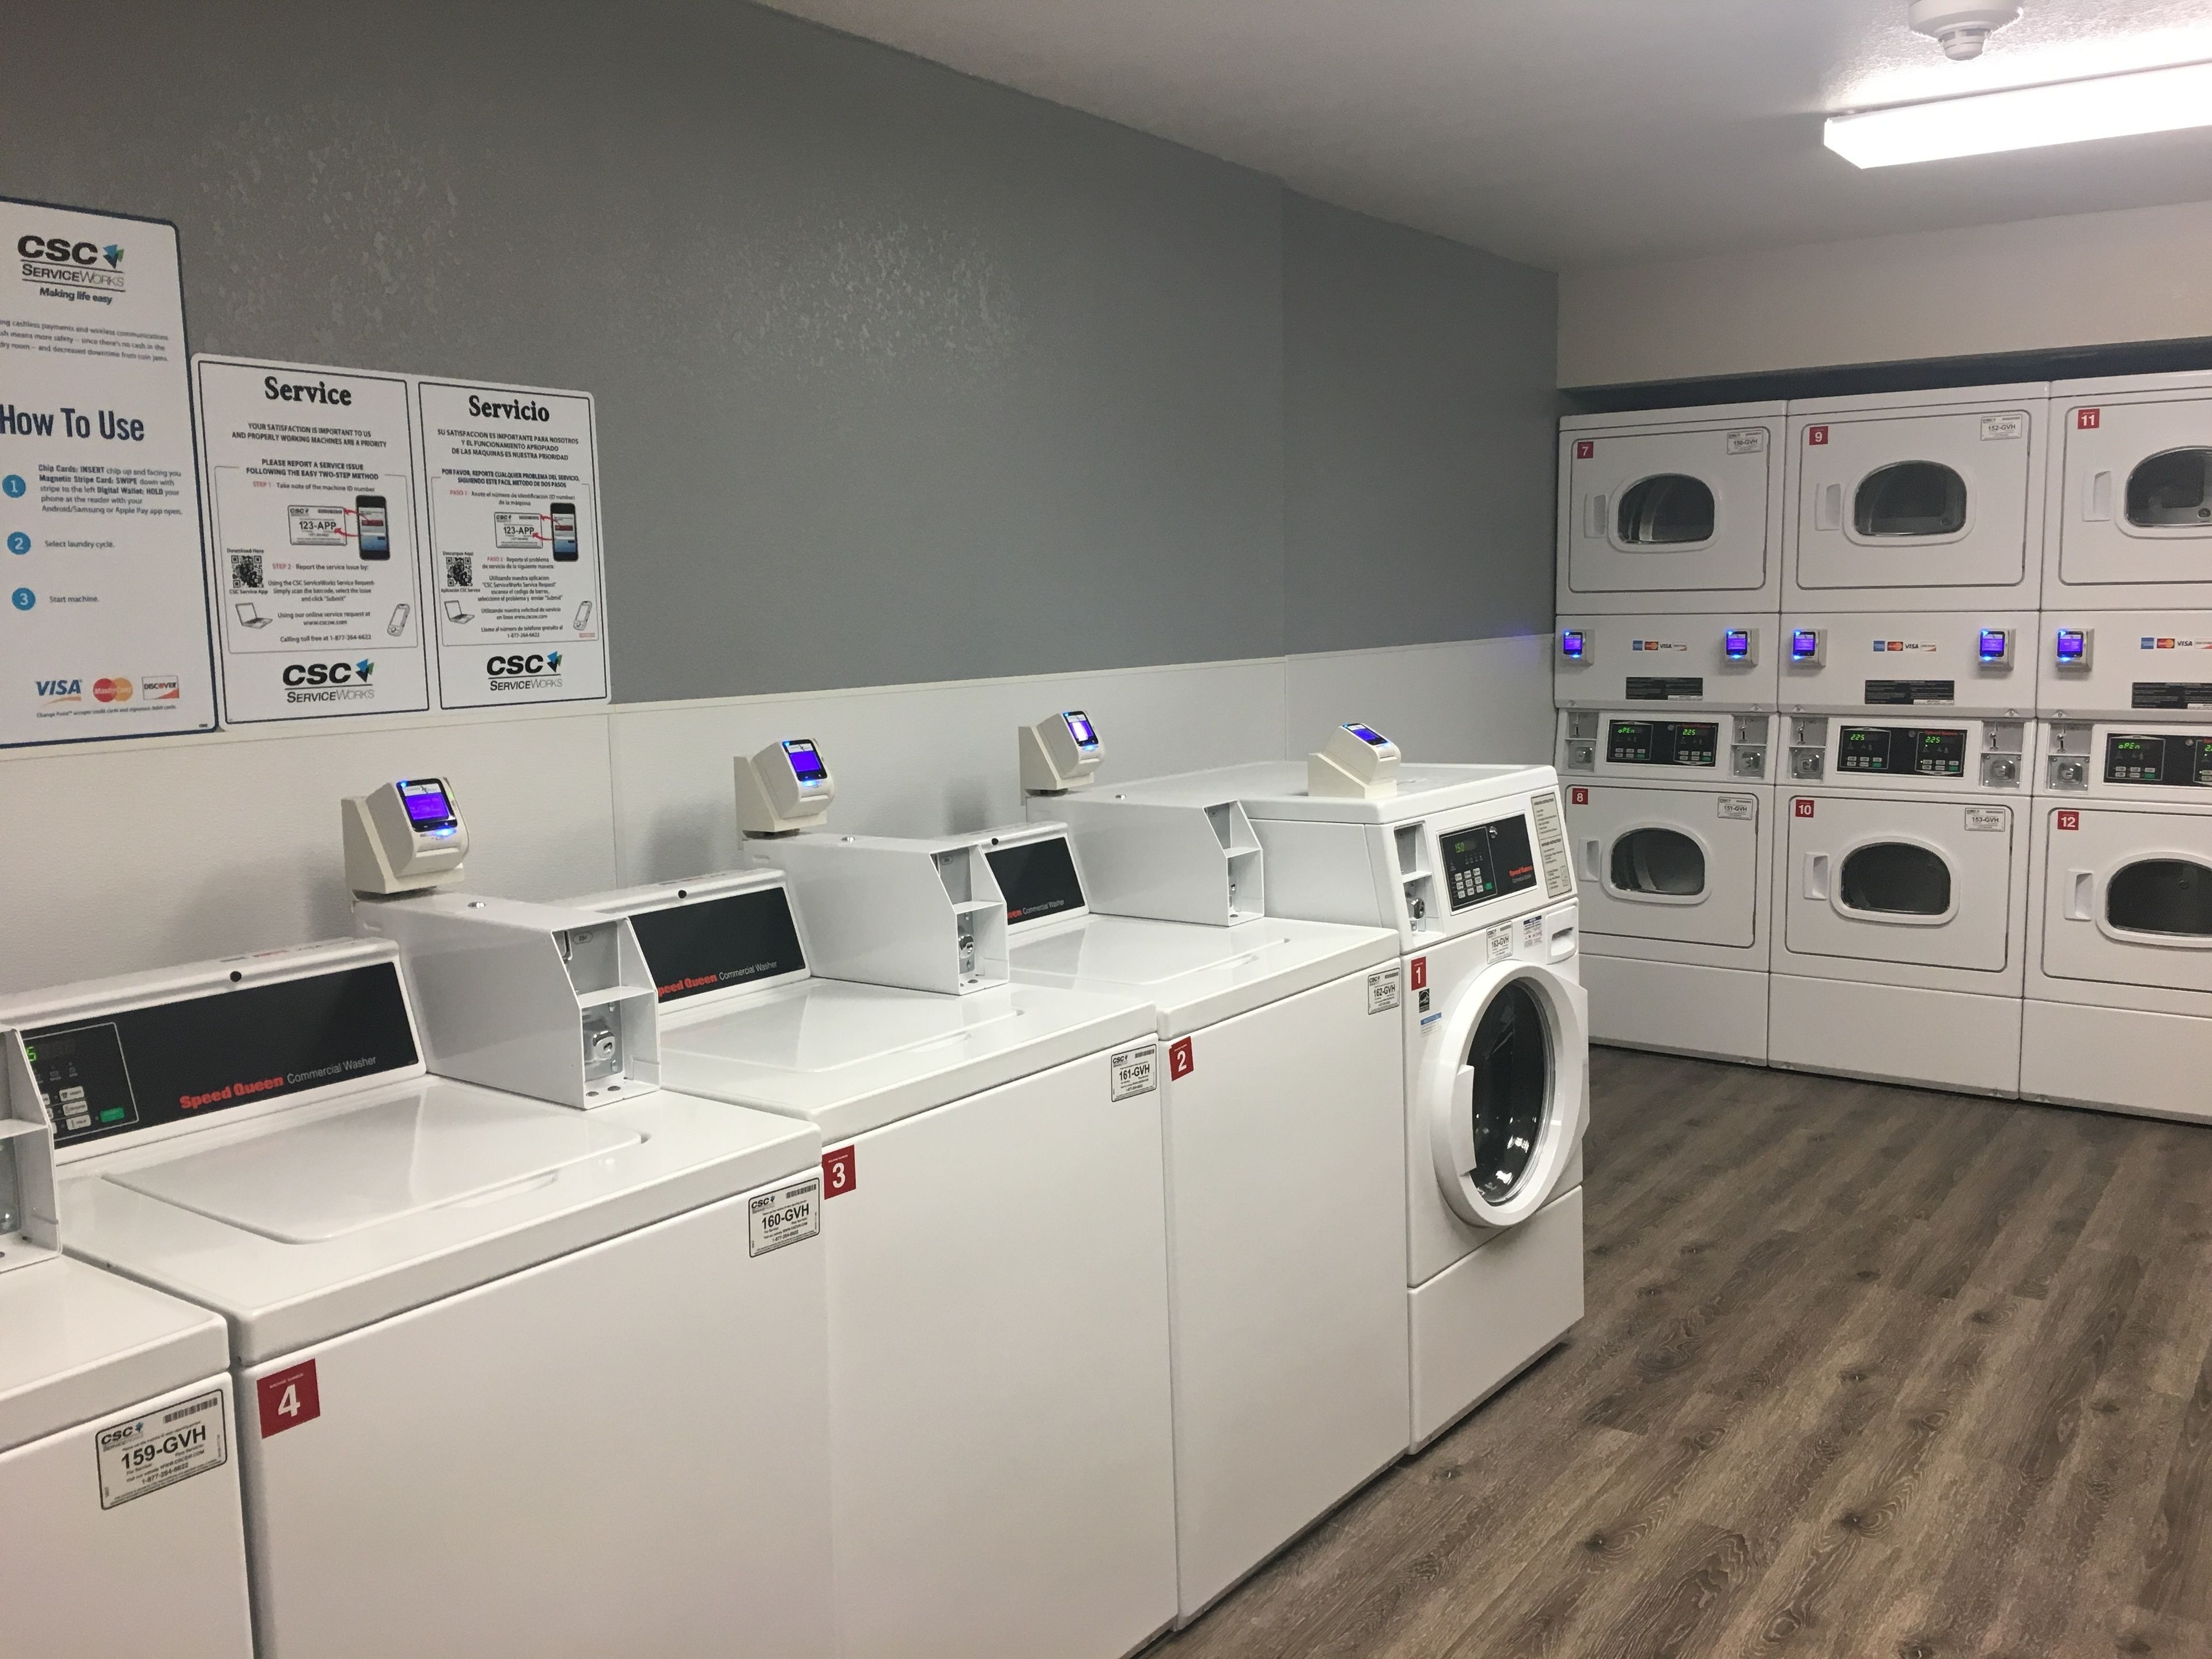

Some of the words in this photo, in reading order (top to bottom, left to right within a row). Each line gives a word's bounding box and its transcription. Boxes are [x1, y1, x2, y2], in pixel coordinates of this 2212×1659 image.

[17, 236, 98, 264] CSC
[40, 287, 75, 301] Making
[77, 291, 90, 300] life
[93, 295, 113, 305] easy
[264, 376, 352, 406] Service
[468, 395, 550, 422] Servicio
[0, 404, 54, 437] How
[60, 407, 90, 438] To
[98, 410, 145, 441] Use
[2081, 415, 2095, 426] 11
[267, 424, 311, 433] SATISFACTION
[318, 427, 353, 436] IMPORTANT
[446, 429, 488, 438] SATISFACCION
[497, 433, 533, 441] IMPORTANTE
[1815, 431, 1823, 442] 9
[247, 433, 279, 441] PROPERLY
[281, 434, 310, 443] WORKING
[311, 437, 342, 445] MACHINES
[474, 440, 525, 449] FUNCIONAMIENTO
[1582, 446, 1589, 456] 7
[39, 464, 54, 472] Chip
[147, 469, 167, 478] facing
[246, 467, 286, 476] FOLLOWING
[39, 475, 71, 483] Magnetic
[74, 476, 94, 484] Stripe
[12, 480, 18, 493] 1
[97, 486, 119, 494] Digital
[41, 495, 63, 503] phone
[42, 505, 105, 514] Android/Samsung
[299, 521, 336, 529] 123-APP
[503, 526, 535, 535] 123-APP
[14, 537, 24, 550] 2
[67, 540, 94, 548] laundry
[20, 593, 28, 605] 3
[487, 654, 543, 676] CSC
[283, 662, 351, 685] CSC
[35, 680, 81, 696] VISA
[1577, 793, 1584, 802] 8
[1798, 804, 1812, 815] 10
[2061, 816, 2075, 827] 12
[1022, 903, 1048, 915] Commercial
[1048, 900, 1064, 908] Washer
[658, 980, 684, 997] peed
[684, 975, 718, 988] Queen
[719, 965, 755, 980] Commercial
[755, 961, 777, 971] Washer
[1416, 967, 1421, 984] 1
[1374, 984, 1395, 998] 162-GVH
[1112, 1056, 1124, 1064] CSC
[1177, 1050, 1187, 1072] 2
[1119, 1063, 1150, 1081] 161-GVH
[179, 1085, 232, 1109] Speed
[233, 1077, 283, 1096] Queen
[287, 1062, 342, 1084] Commercial
[342, 1056, 376, 1070] Washer
[832, 1162, 845, 1188] 3
[752, 1198, 769, 1209] CSC
[762, 1203, 809, 1229] 160-GVH
[278, 1384, 301, 1417] 4
[101, 1426, 133, 1445] CSC
[121, 1425, 206, 1469] 159-GVH
